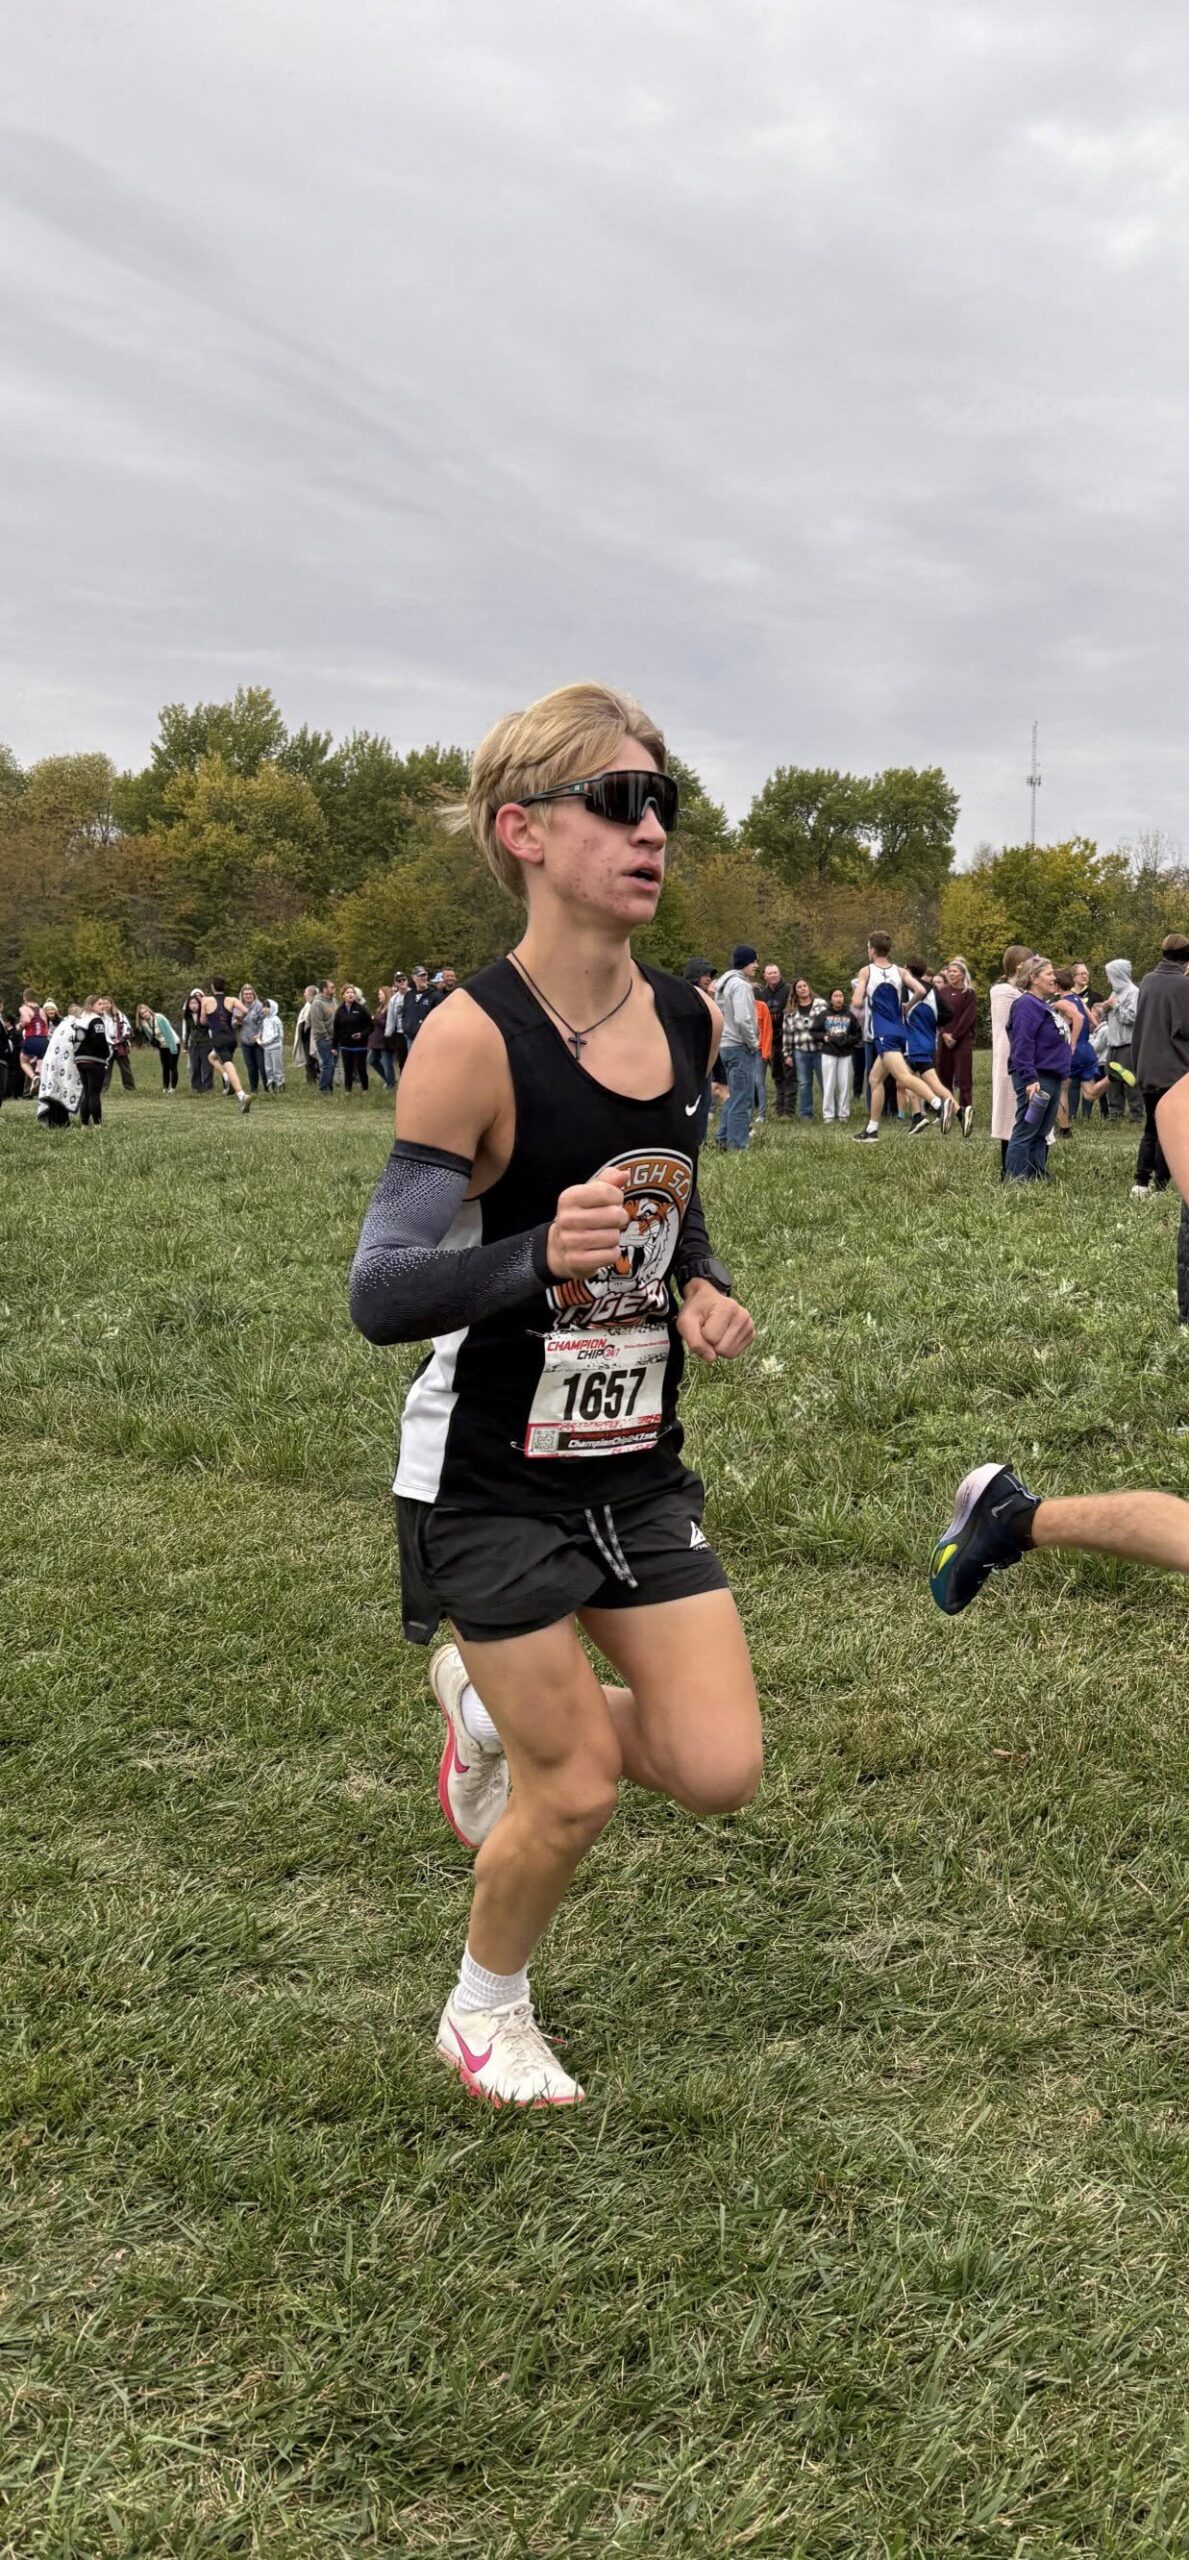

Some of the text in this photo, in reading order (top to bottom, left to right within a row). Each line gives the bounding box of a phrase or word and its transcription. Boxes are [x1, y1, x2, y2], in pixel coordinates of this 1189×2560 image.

[621, 1164, 668, 1190] IGH
[547, 1338, 607, 1351] CHAMPION
[577, 1349, 605, 1360] CHIP
[563, 1366, 647, 1421] 1657
